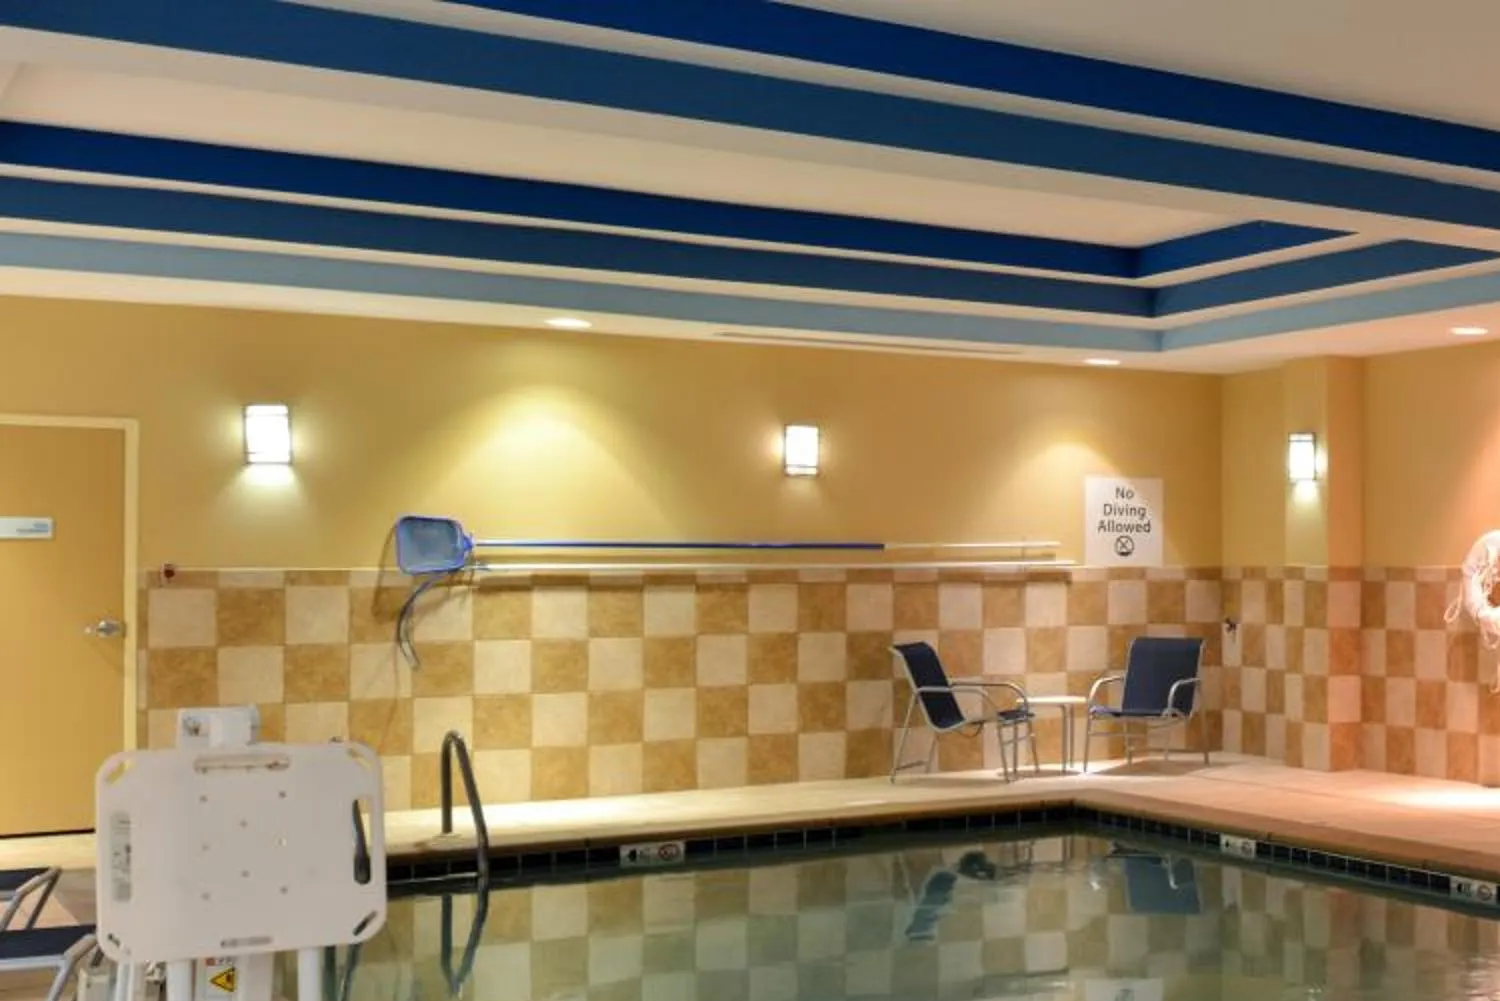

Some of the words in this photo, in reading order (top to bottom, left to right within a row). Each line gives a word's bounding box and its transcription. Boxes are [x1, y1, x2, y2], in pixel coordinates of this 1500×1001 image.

[1115, 487, 1135, 499] No
[1103, 503, 1147, 520] Diving
[1097, 520, 1151, 534] Allowed
